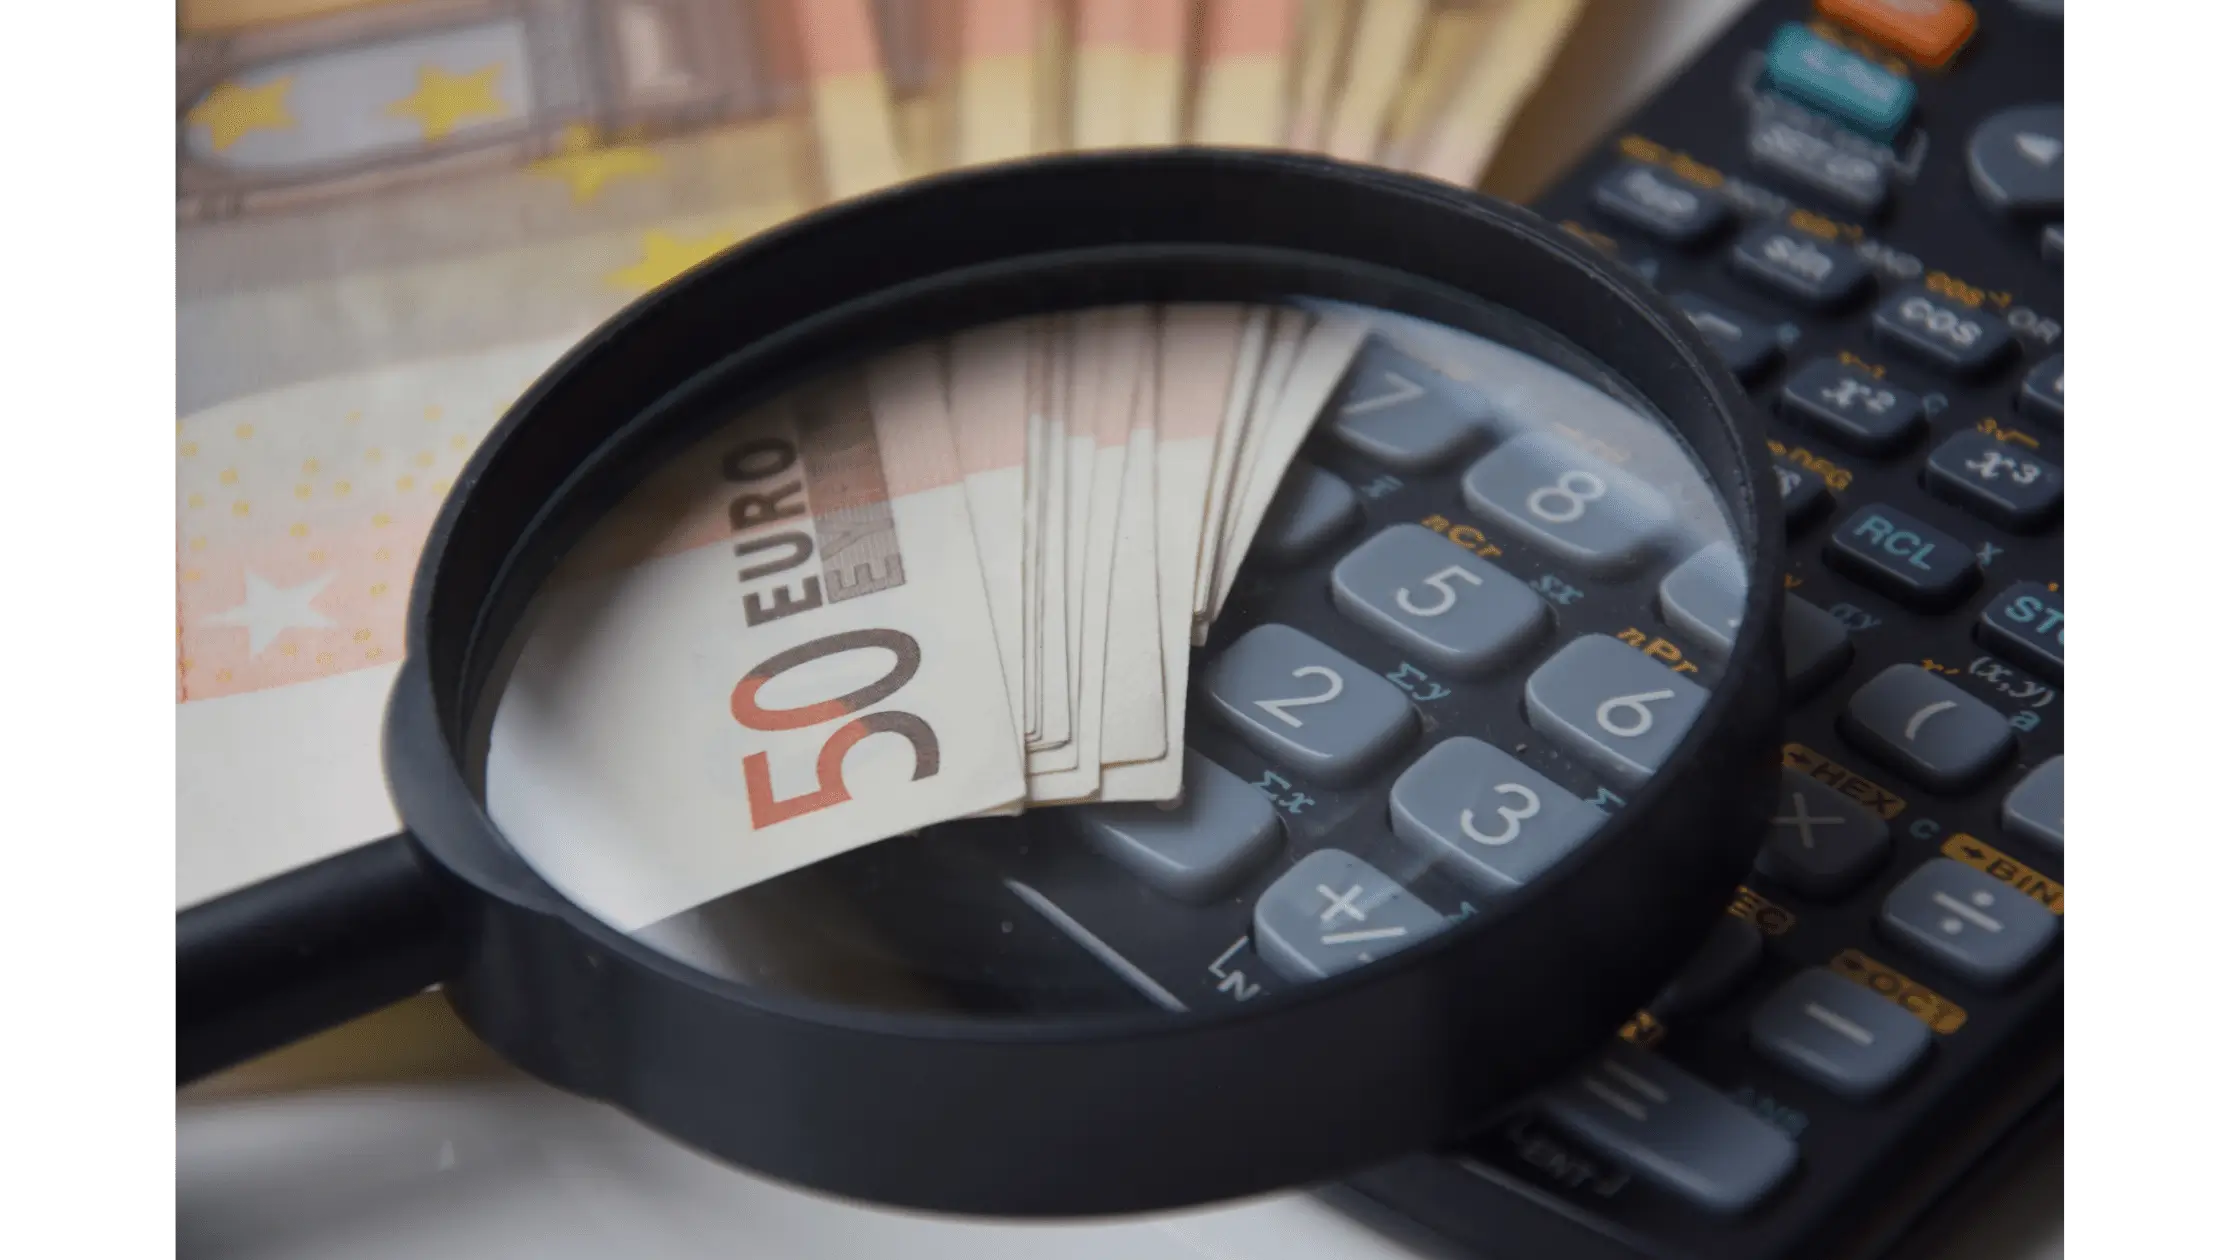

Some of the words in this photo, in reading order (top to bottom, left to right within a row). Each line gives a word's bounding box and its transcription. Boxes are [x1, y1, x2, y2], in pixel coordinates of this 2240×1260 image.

[1526, 469, 1607, 524] 8
[722, 437, 825, 628] EURO
[1420, 513, 1503, 558] nCr
[1853, 514, 1937, 572] RCL
[1396, 564, 1484, 618] 5
[2004, 595, 2064, 647] ST
[1616, 626, 1698, 673] nPr
[1252, 664, 1345, 729] 2
[1595, 688, 1677, 739] 6
[729, 628, 940, 831] 50
[1458, 782, 1542, 847] 3
